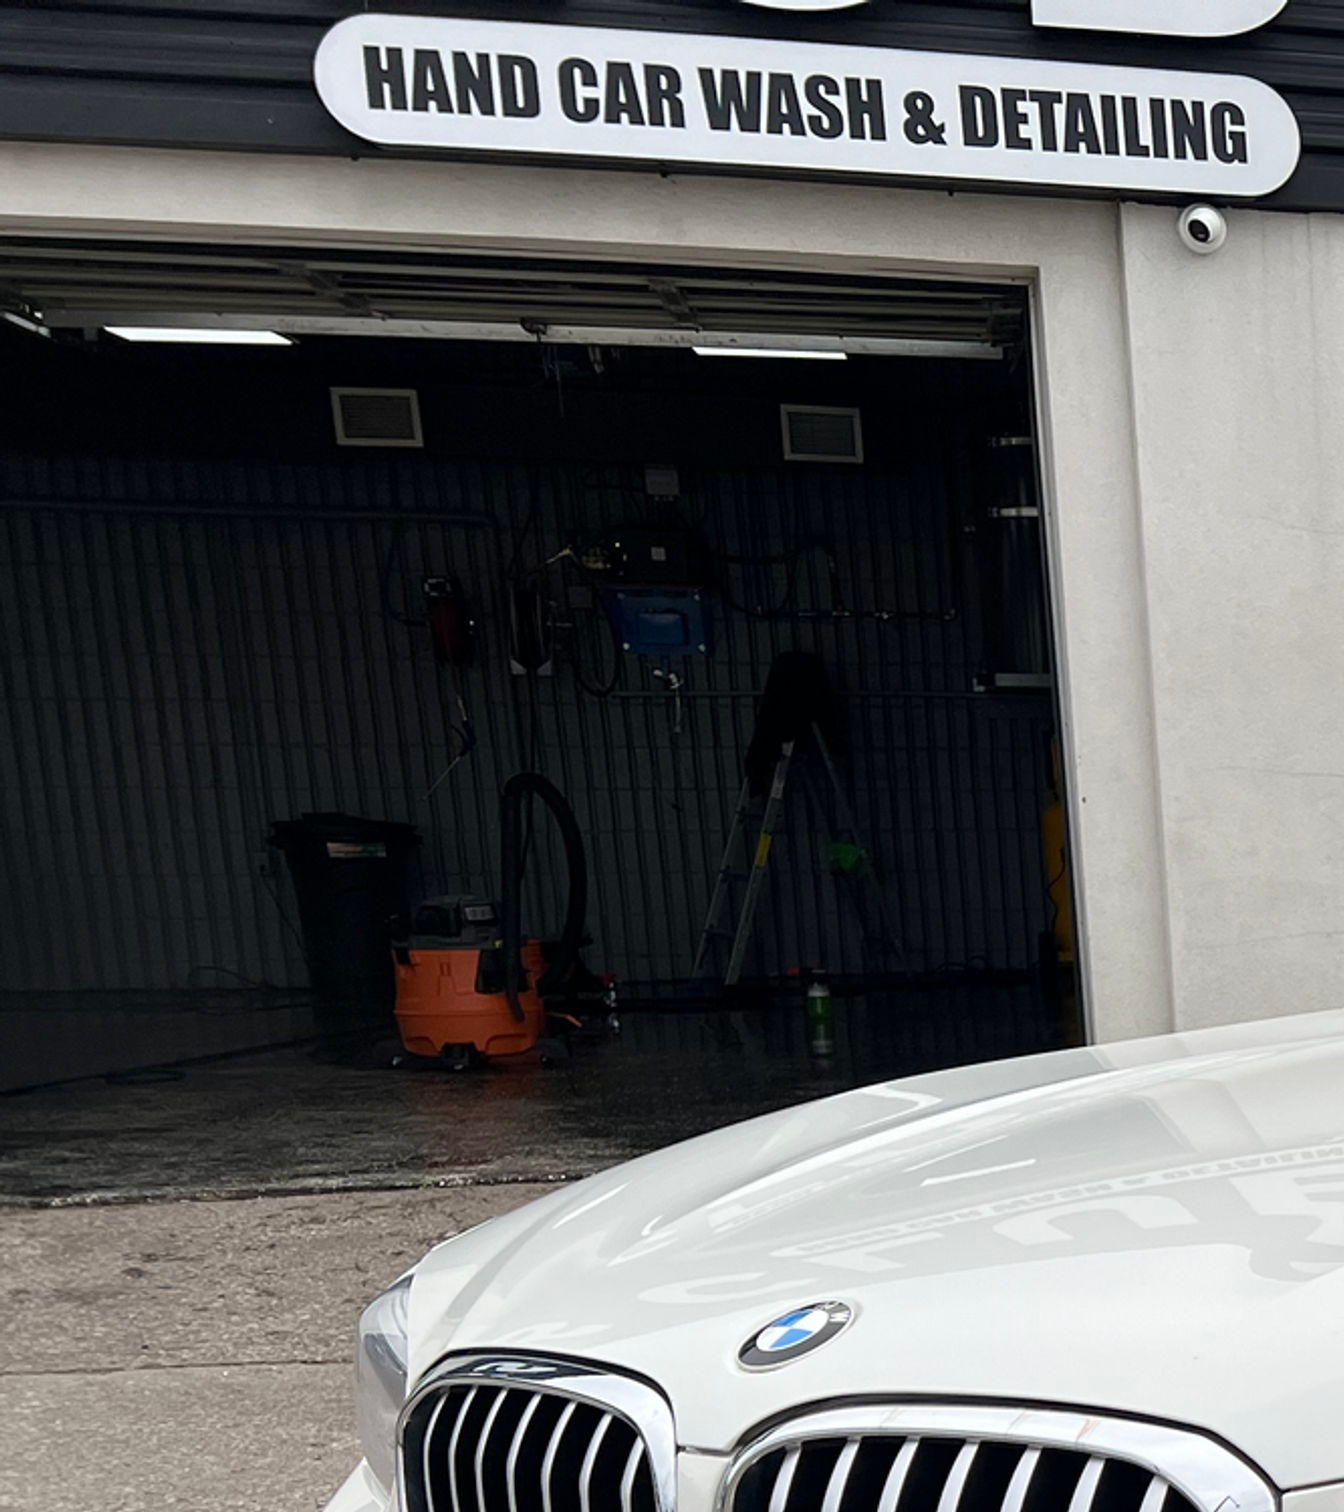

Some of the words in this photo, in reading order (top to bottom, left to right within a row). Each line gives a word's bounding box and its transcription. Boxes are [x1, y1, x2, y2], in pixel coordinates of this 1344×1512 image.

[362, 45, 541, 119] HAND
[557, 57, 686, 129] CAR
[697, 67, 887, 142] WASH
[902, 91, 947, 146] &
[958, 84, 1249, 164] DETAILING
